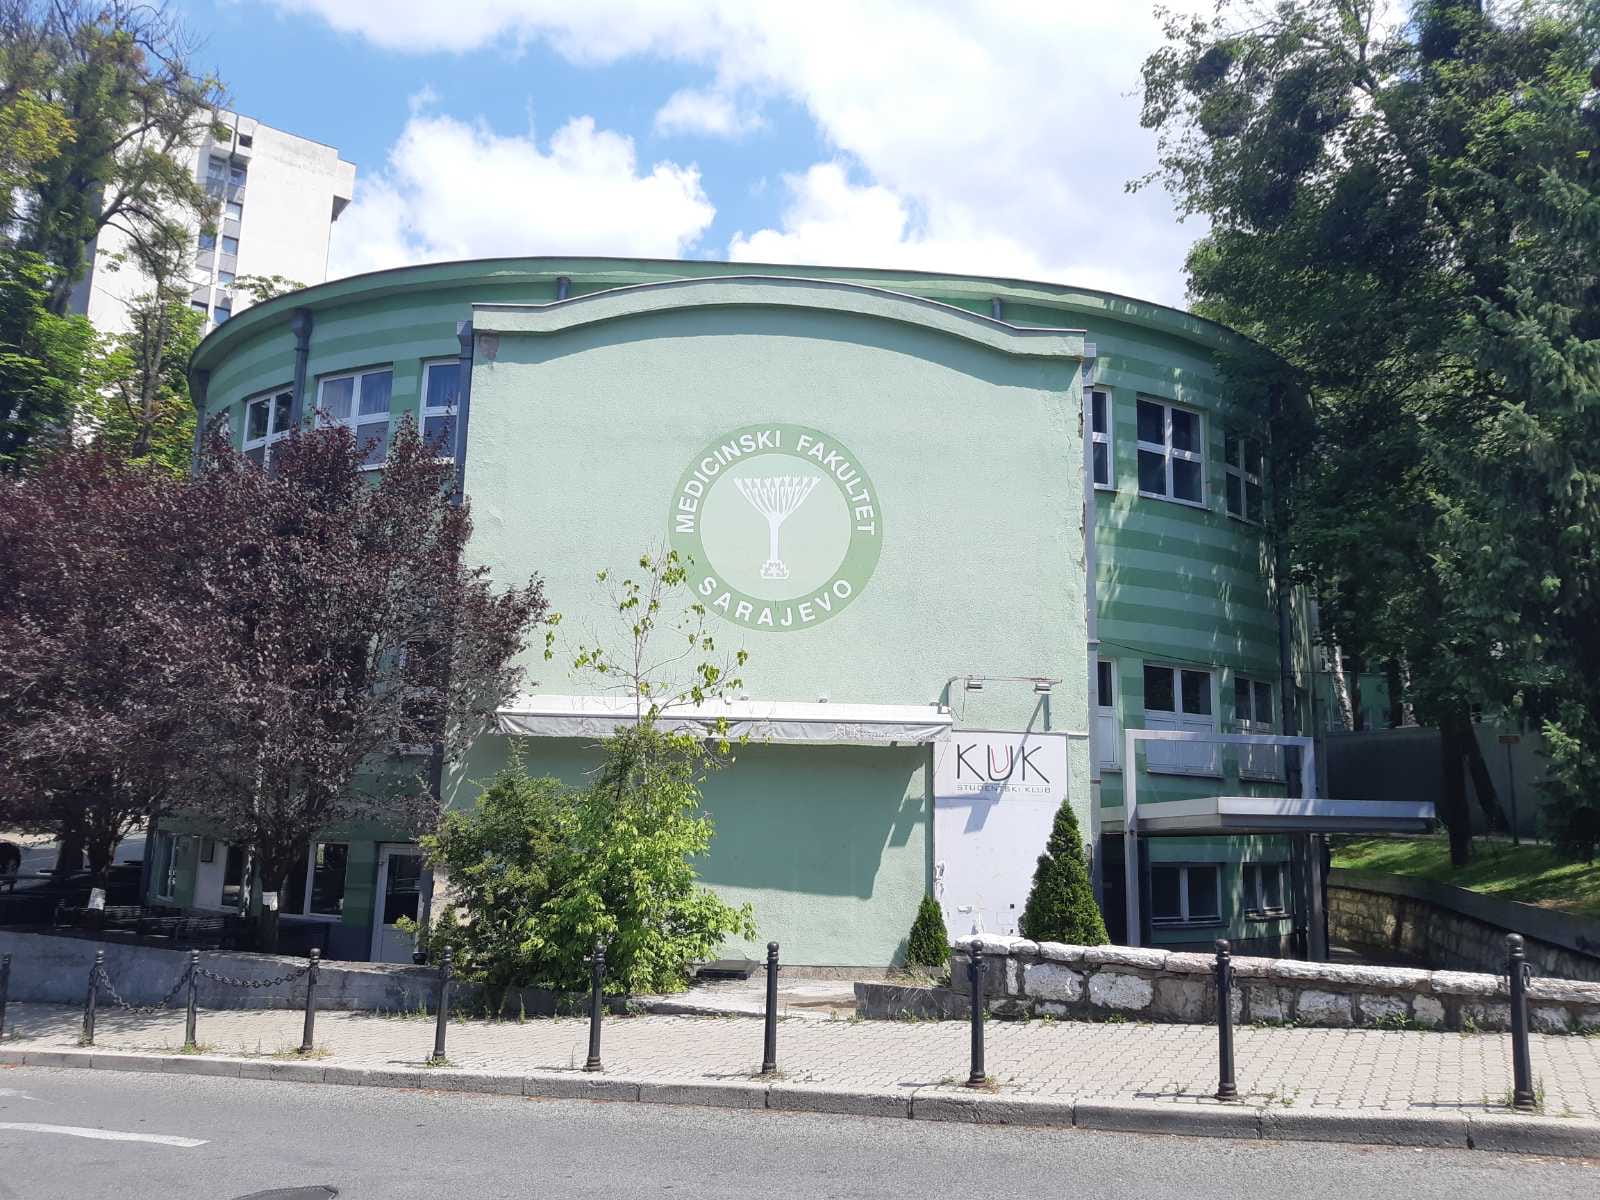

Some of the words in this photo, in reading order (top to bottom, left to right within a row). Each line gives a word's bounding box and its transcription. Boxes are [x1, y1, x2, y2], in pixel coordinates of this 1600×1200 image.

[675, 430, 781, 533] MEDICINSKI
[796, 434, 875, 537] FAKULTET
[698, 576, 852, 627] SARAJEVO
[956, 744, 1050, 784] KUK
[956, 784, 1020, 793] STUDENTSKI
[1024, 785, 1051, 794] KLUB
